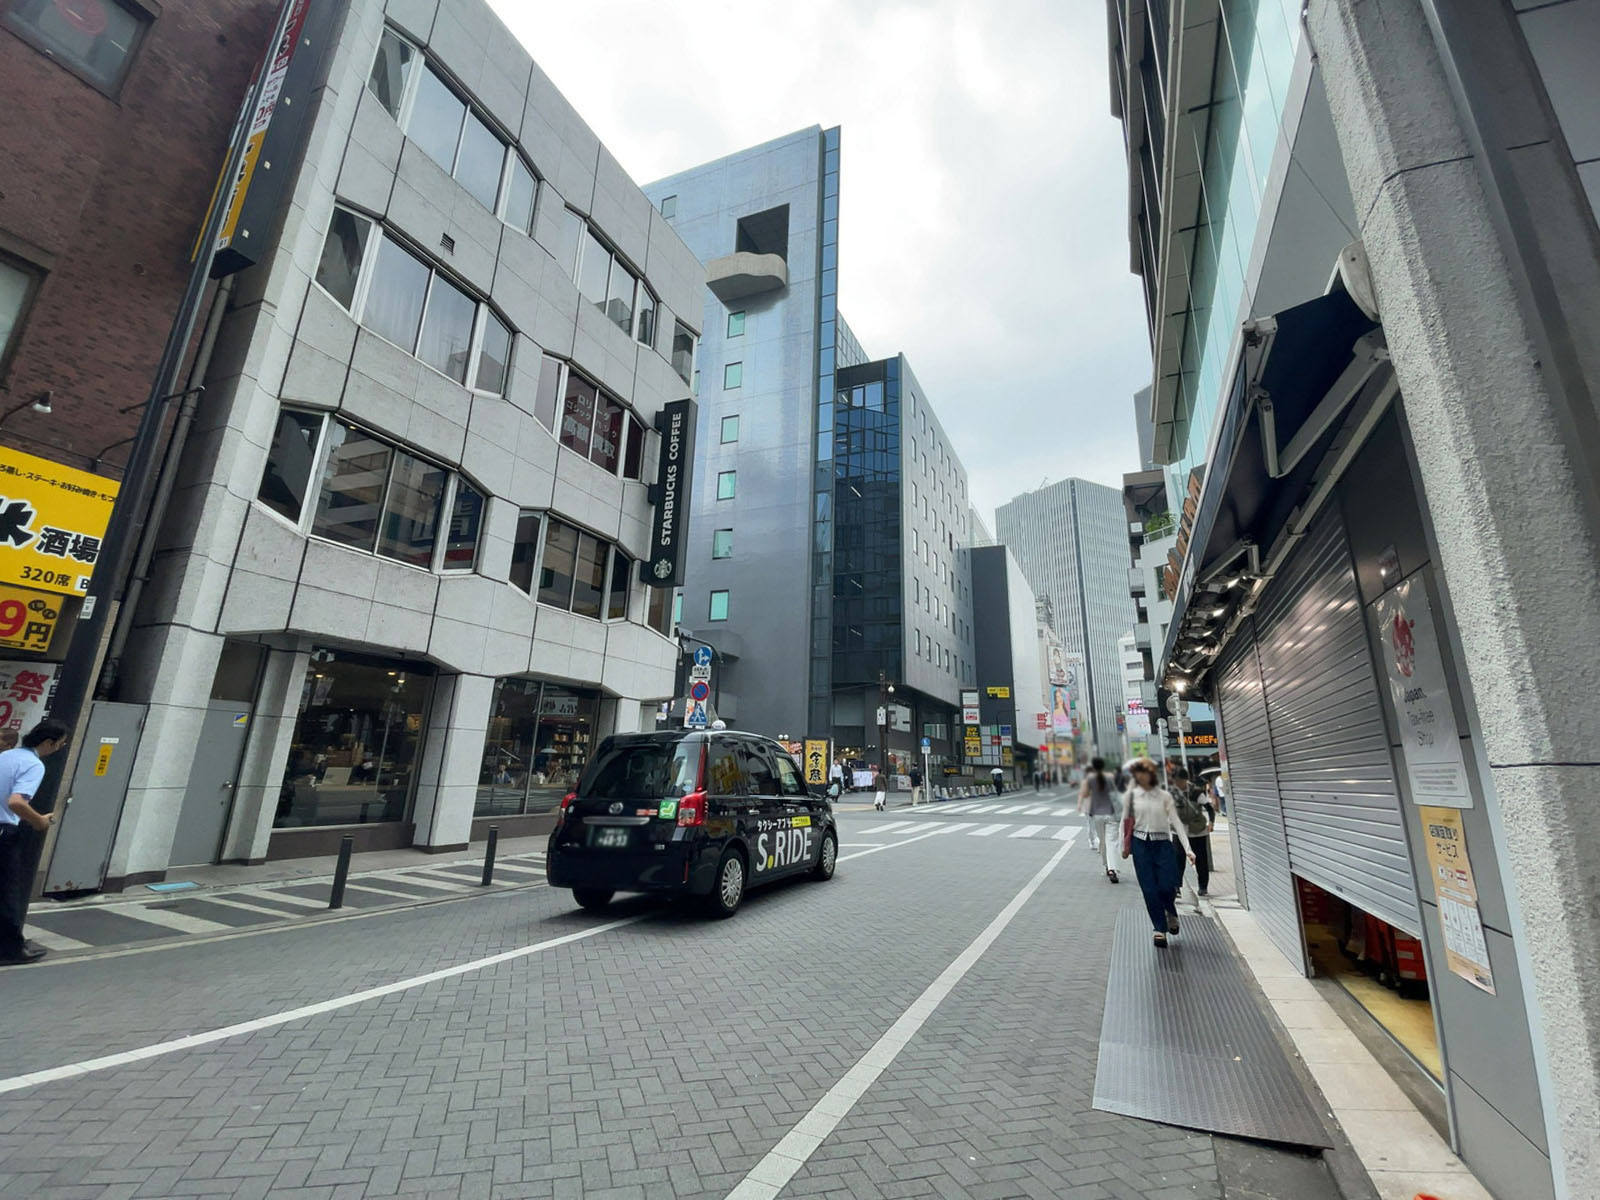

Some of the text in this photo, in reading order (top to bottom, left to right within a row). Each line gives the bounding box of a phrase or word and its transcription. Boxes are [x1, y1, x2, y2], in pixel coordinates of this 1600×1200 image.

[661, 412, 682, 546] STARBUCKS COFFEE
[35, 525, 101, 564] 酒場
[20, 565, 71, 587] 320席
[756, 827, 812, 872] S.RIDE
